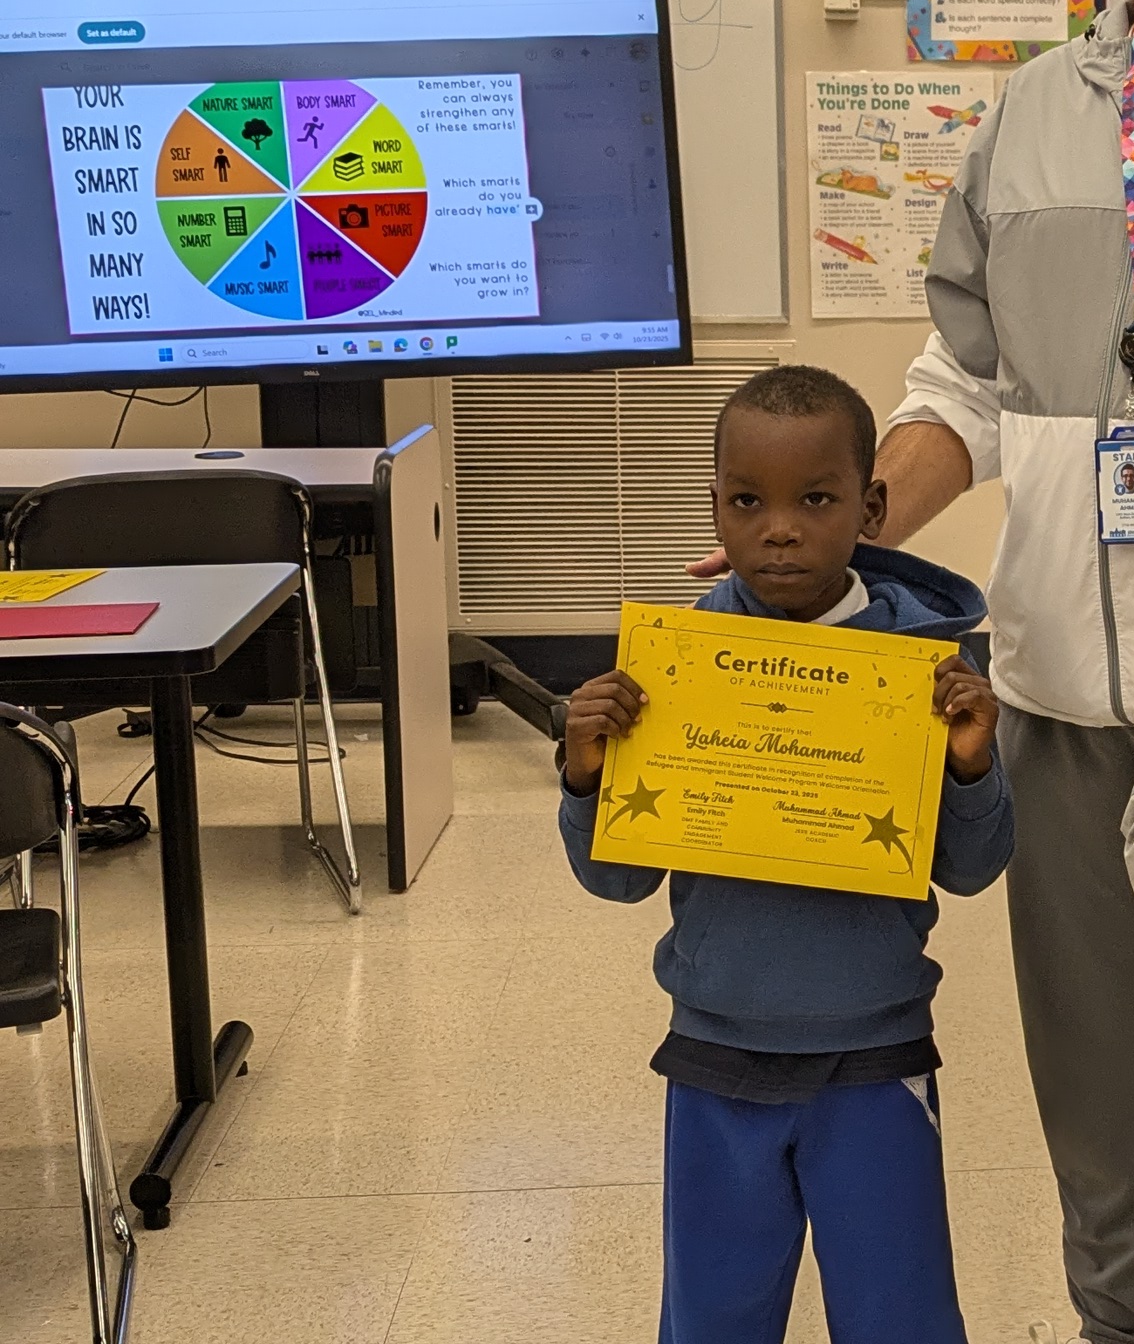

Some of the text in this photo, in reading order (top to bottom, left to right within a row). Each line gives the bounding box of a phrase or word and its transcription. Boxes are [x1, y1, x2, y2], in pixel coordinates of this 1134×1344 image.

[418, 80, 512, 90] Remember, you
[817, 83, 960, 96] Things to Do When
[74, 86, 124, 108] YOUR
[297, 95, 356, 109] BODY SMART
[443, 93, 513, 103] can always
[203, 97, 273, 112] NATURE SMART
[817, 98, 910, 110] You're Done
[420, 108, 514, 119] strengthen any
[417, 121, 516, 133] of these smarts!
[818, 124, 842, 132] Read
[62, 125, 141, 151] BRAIN IS
[904, 131, 929, 139] Draw
[373, 140, 401, 153] WORD
[170, 148, 191, 160] SELF
[372, 161, 403, 174] SMART
[75, 167, 139, 194] SMART
[173, 168, 204, 182] SMART
[443, 177, 520, 188] Which smarts
[479, 191, 521, 201] do you
[820, 192, 845, 200] Make
[905, 199, 937, 207] Design
[375, 204, 412, 216] PICTURE
[435, 207, 482, 217] already
[87, 211, 136, 236] IN SO
[178, 214, 216, 227] NUMBER
[382, 224, 412, 237] SMART
[180, 234, 211, 248] SMART
[90, 253, 144, 278] MANY
[430, 260, 527, 272] Which smarts do
[822, 262, 848, 270] Write
[906, 269, 923, 277] List
[454, 274, 528, 286] you want to
[225, 281, 289, 295] MUSIC SMART
[478, 287, 529, 299] grow in?
[93, 293, 150, 320] WAYS!
[202, 348, 228, 357] Search
[715, 650, 849, 684] Certificate
[730, 677, 830, 696] OF ACHIEVEMENT
[754, 733, 865, 764] Mohammed
